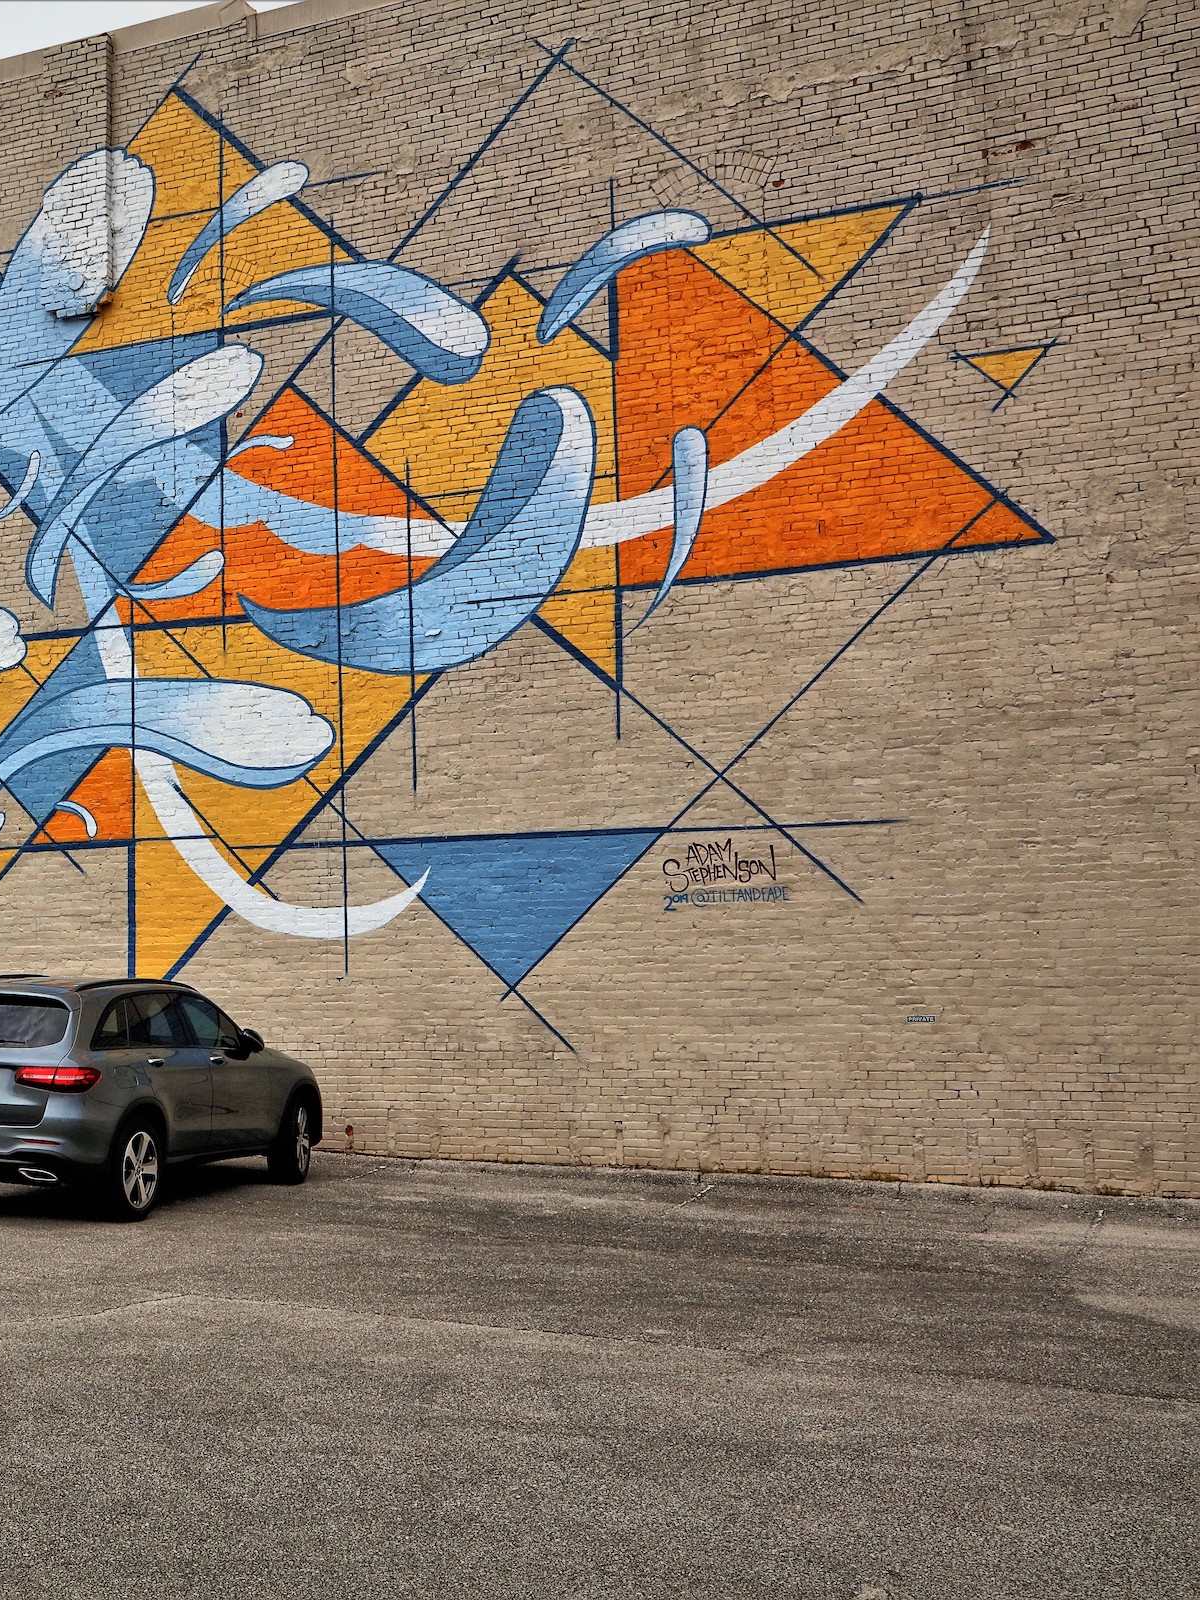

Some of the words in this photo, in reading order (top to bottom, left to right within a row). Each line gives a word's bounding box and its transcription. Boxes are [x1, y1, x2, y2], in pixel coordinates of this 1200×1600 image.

[686, 838, 732, 866] ADAM
[662, 845, 776, 892] STEPHENSON
[663, 894, 688, 911] 2019
[691, 886, 789, 907] @TILTANDFADE
